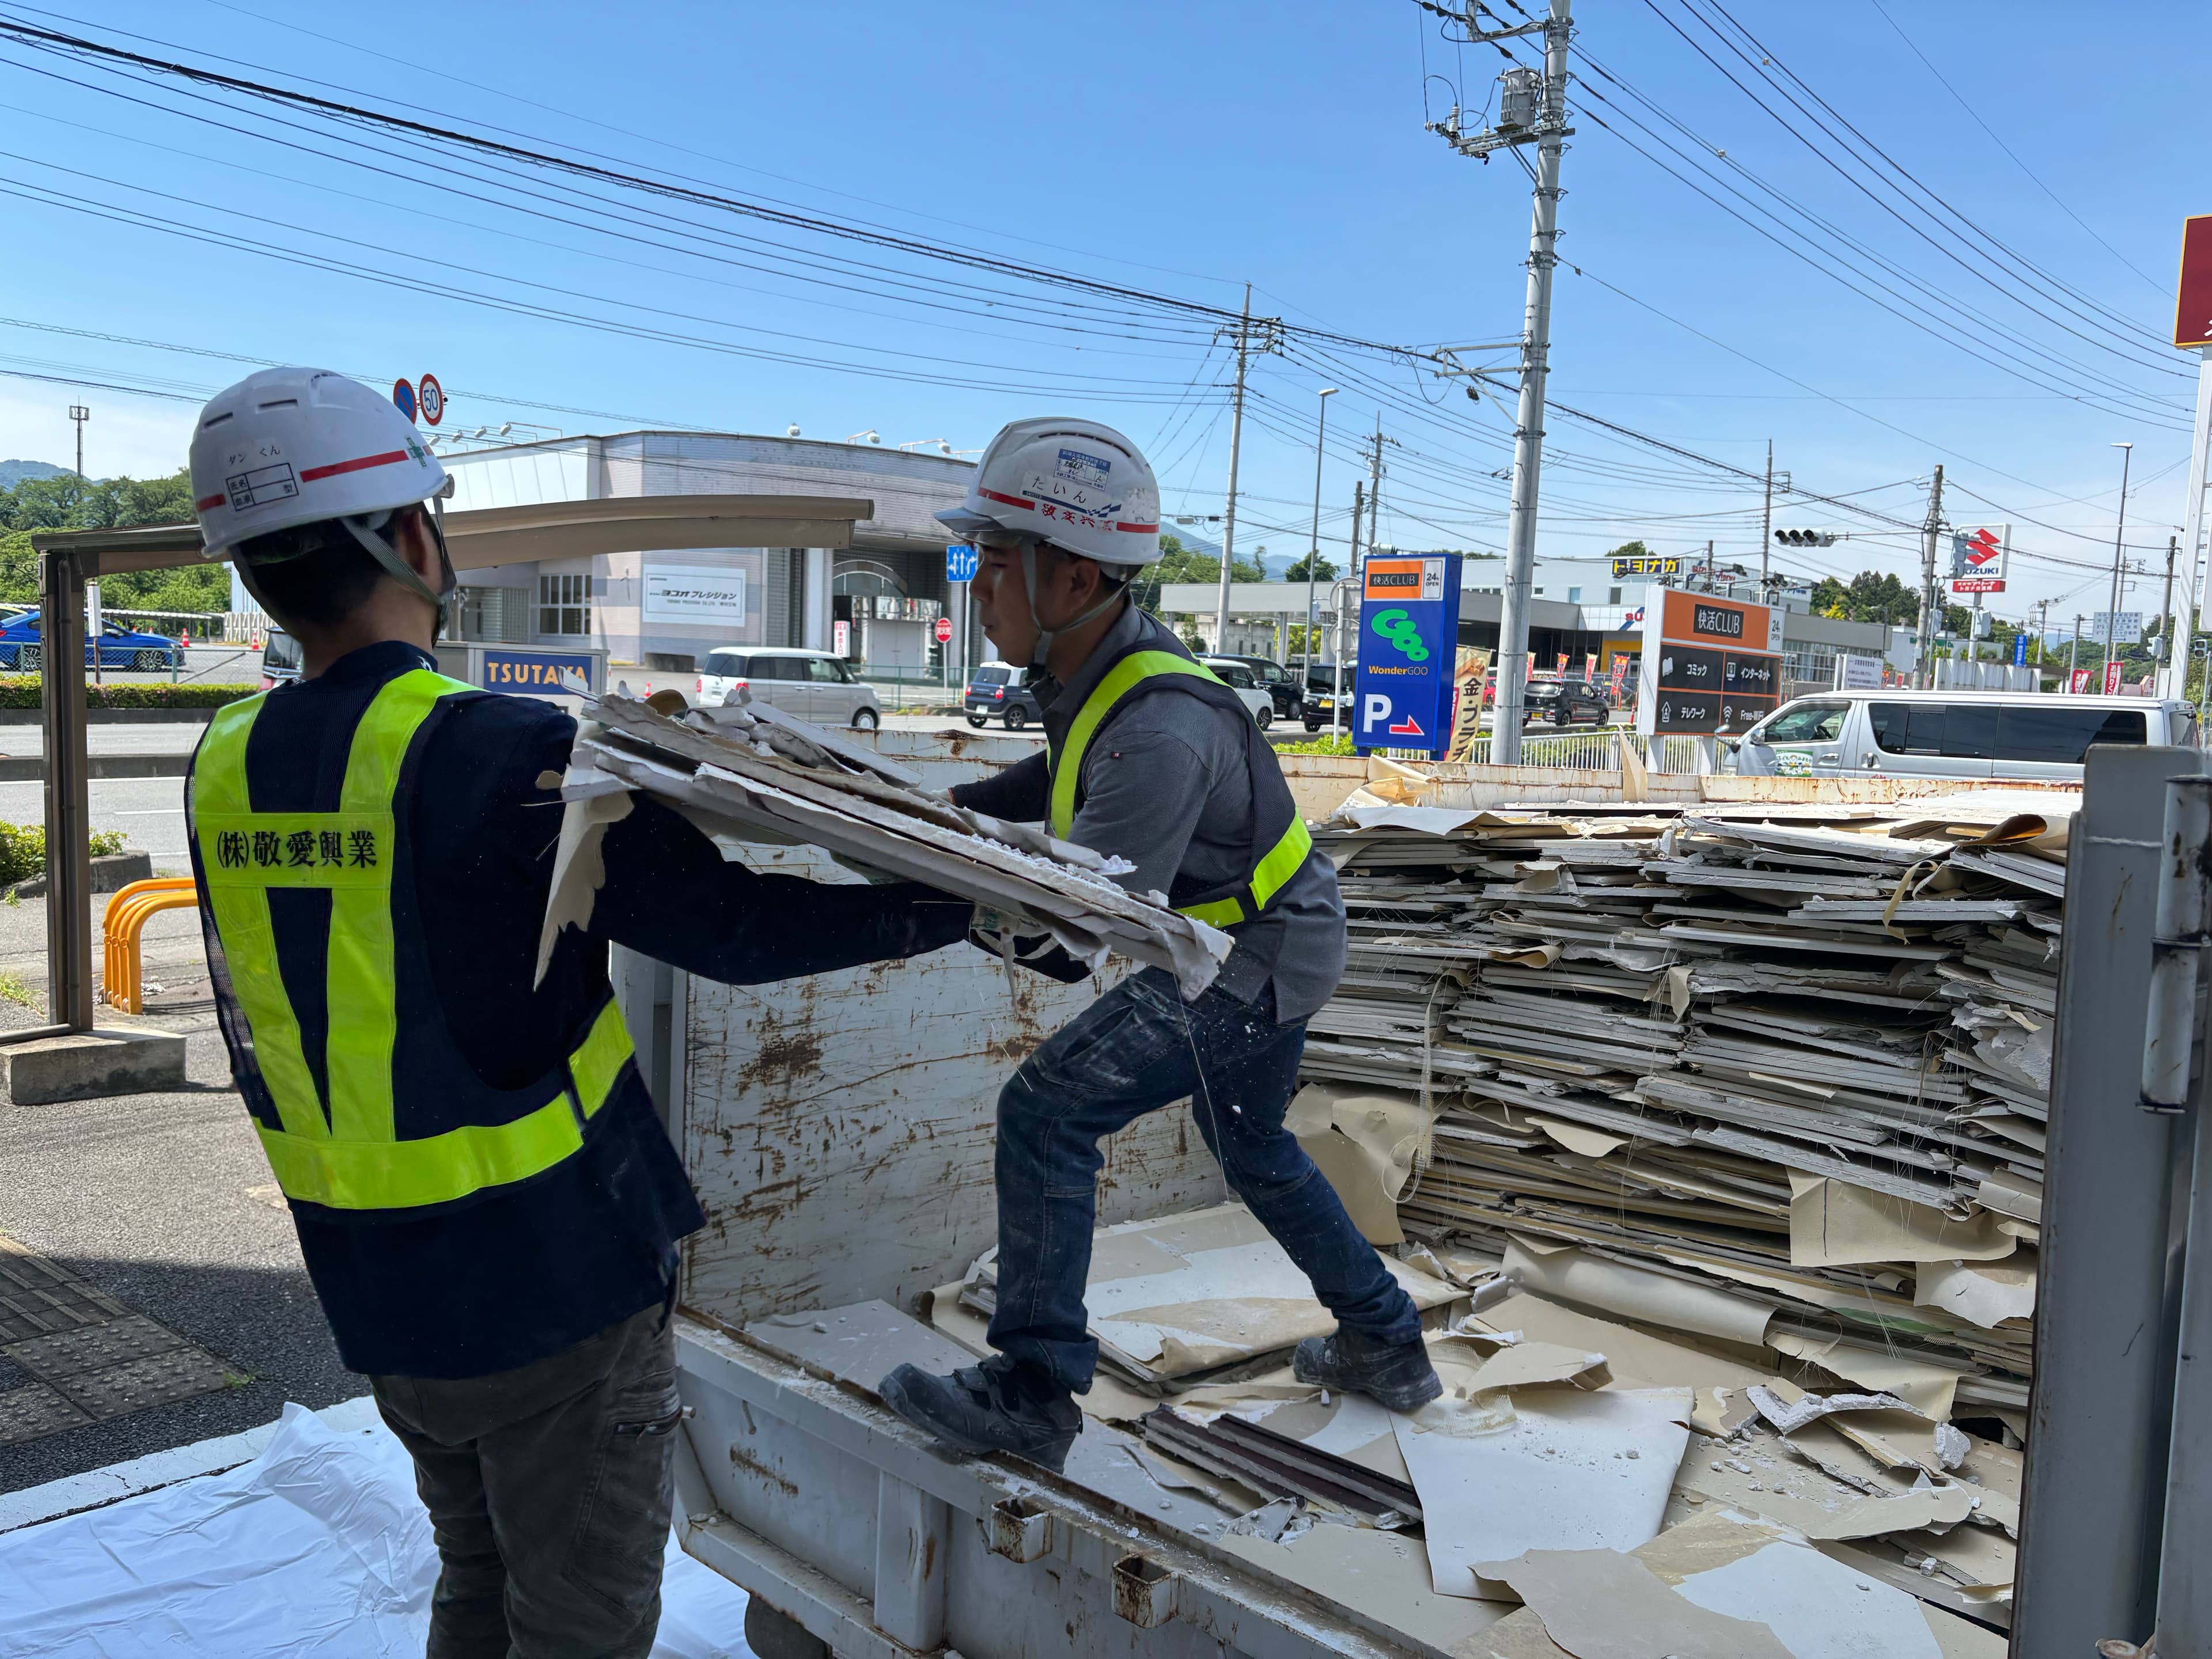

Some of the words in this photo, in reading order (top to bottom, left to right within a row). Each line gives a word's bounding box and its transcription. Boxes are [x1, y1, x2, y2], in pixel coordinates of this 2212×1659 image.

[423, 389, 438, 412] 50
[230, 479, 247, 490] 氏名
[1032, 476, 1086, 503] たいん
[1613, 559, 1680, 574] トヨナガ
[1373, 575, 1415, 586] 快活CLUB
[1426, 573, 1440, 581] 24h
[1625, 612, 1645, 622] SU
[1698, 609, 1740, 634] 快活CLUB
[488, 662, 587, 685] TSUTAA
[1368, 665, 1428, 676] WonderGOO
[1687, 664, 1707, 677] コミック
[1741, 667, 1771, 681] インターネット
[1363, 694, 1392, 733] P
[1681, 706, 1706, 719] テレワーク
[217, 830, 377, 868] (株)敬愛興業
